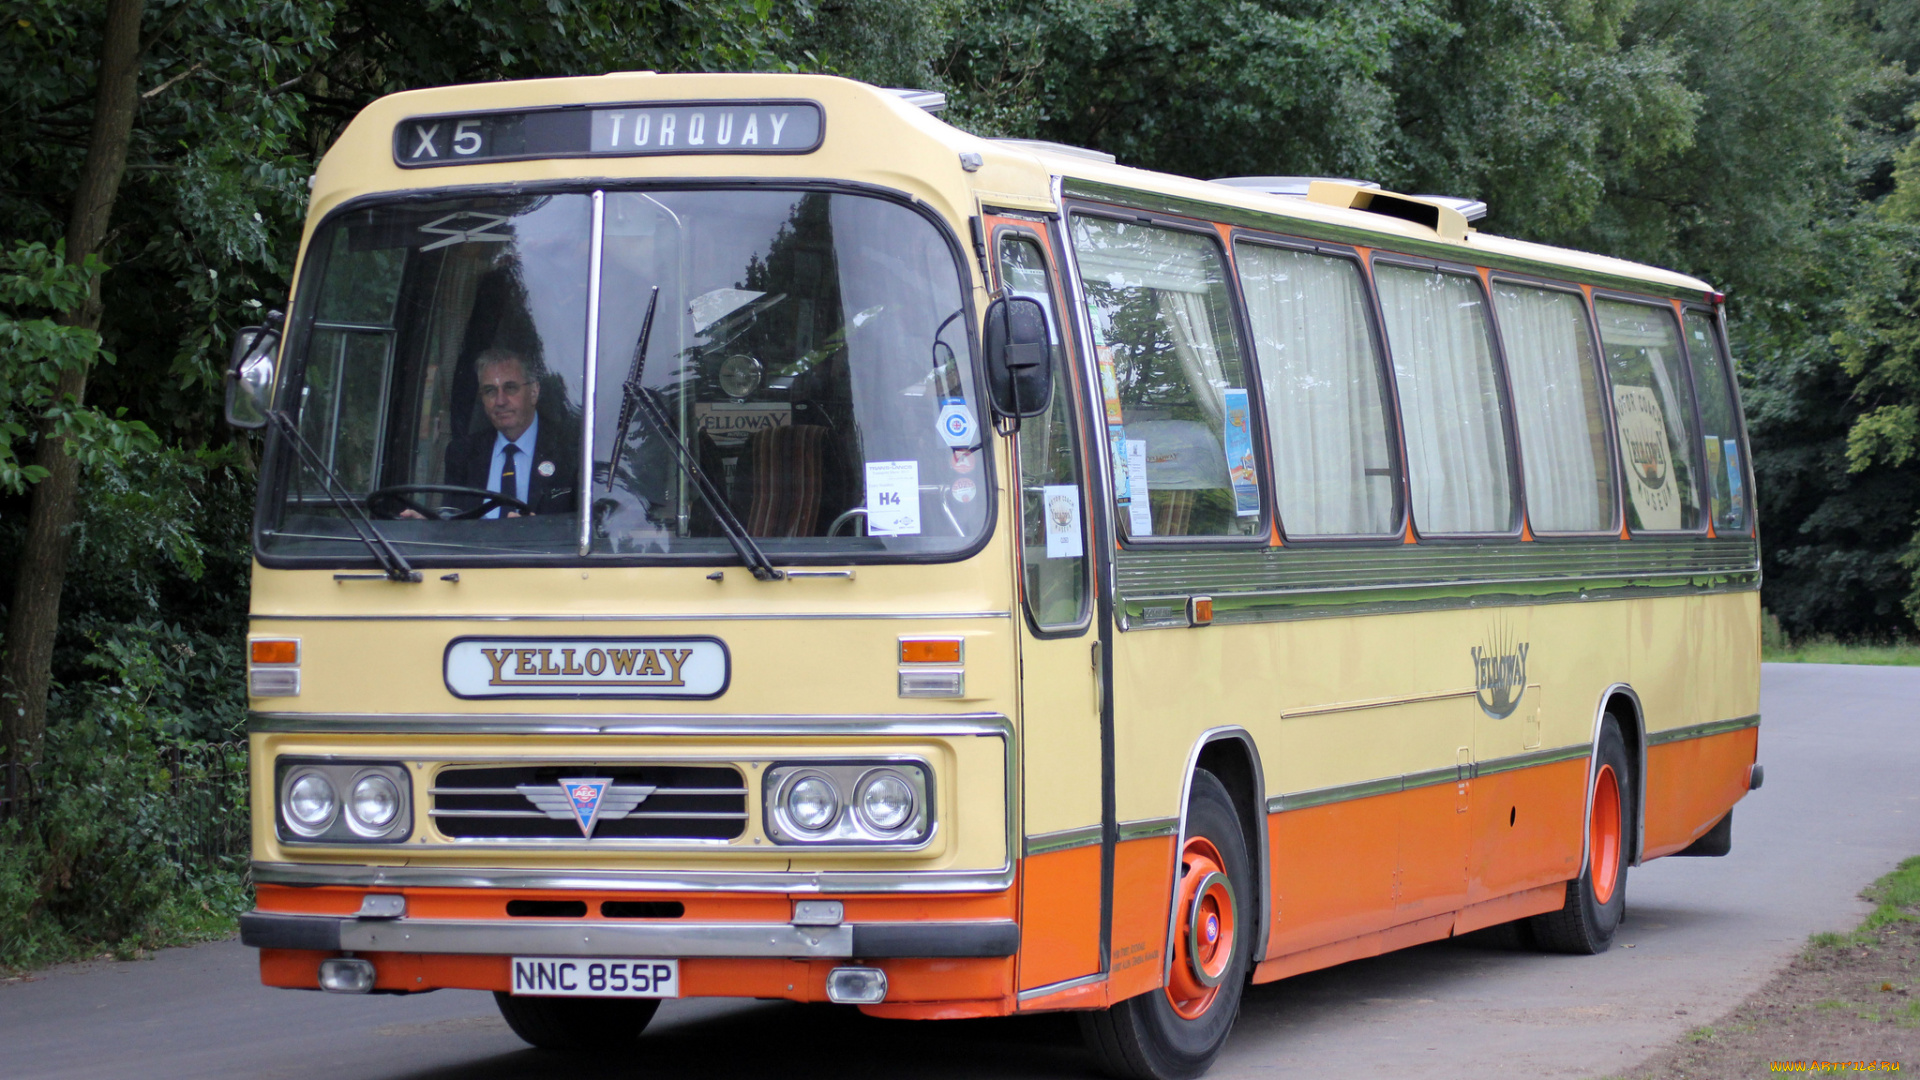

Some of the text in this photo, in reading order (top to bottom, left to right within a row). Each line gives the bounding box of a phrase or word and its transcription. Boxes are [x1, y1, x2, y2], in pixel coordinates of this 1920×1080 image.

[609, 112, 790, 147] TORQUAY
[696, 412, 788, 430] YELLOWAY
[879, 491, 901, 506] H4
[480, 648, 694, 687] YELLOWAY
[1470, 642, 1530, 690] YELLOWAY
[515, 961, 672, 993] NNC 855P
